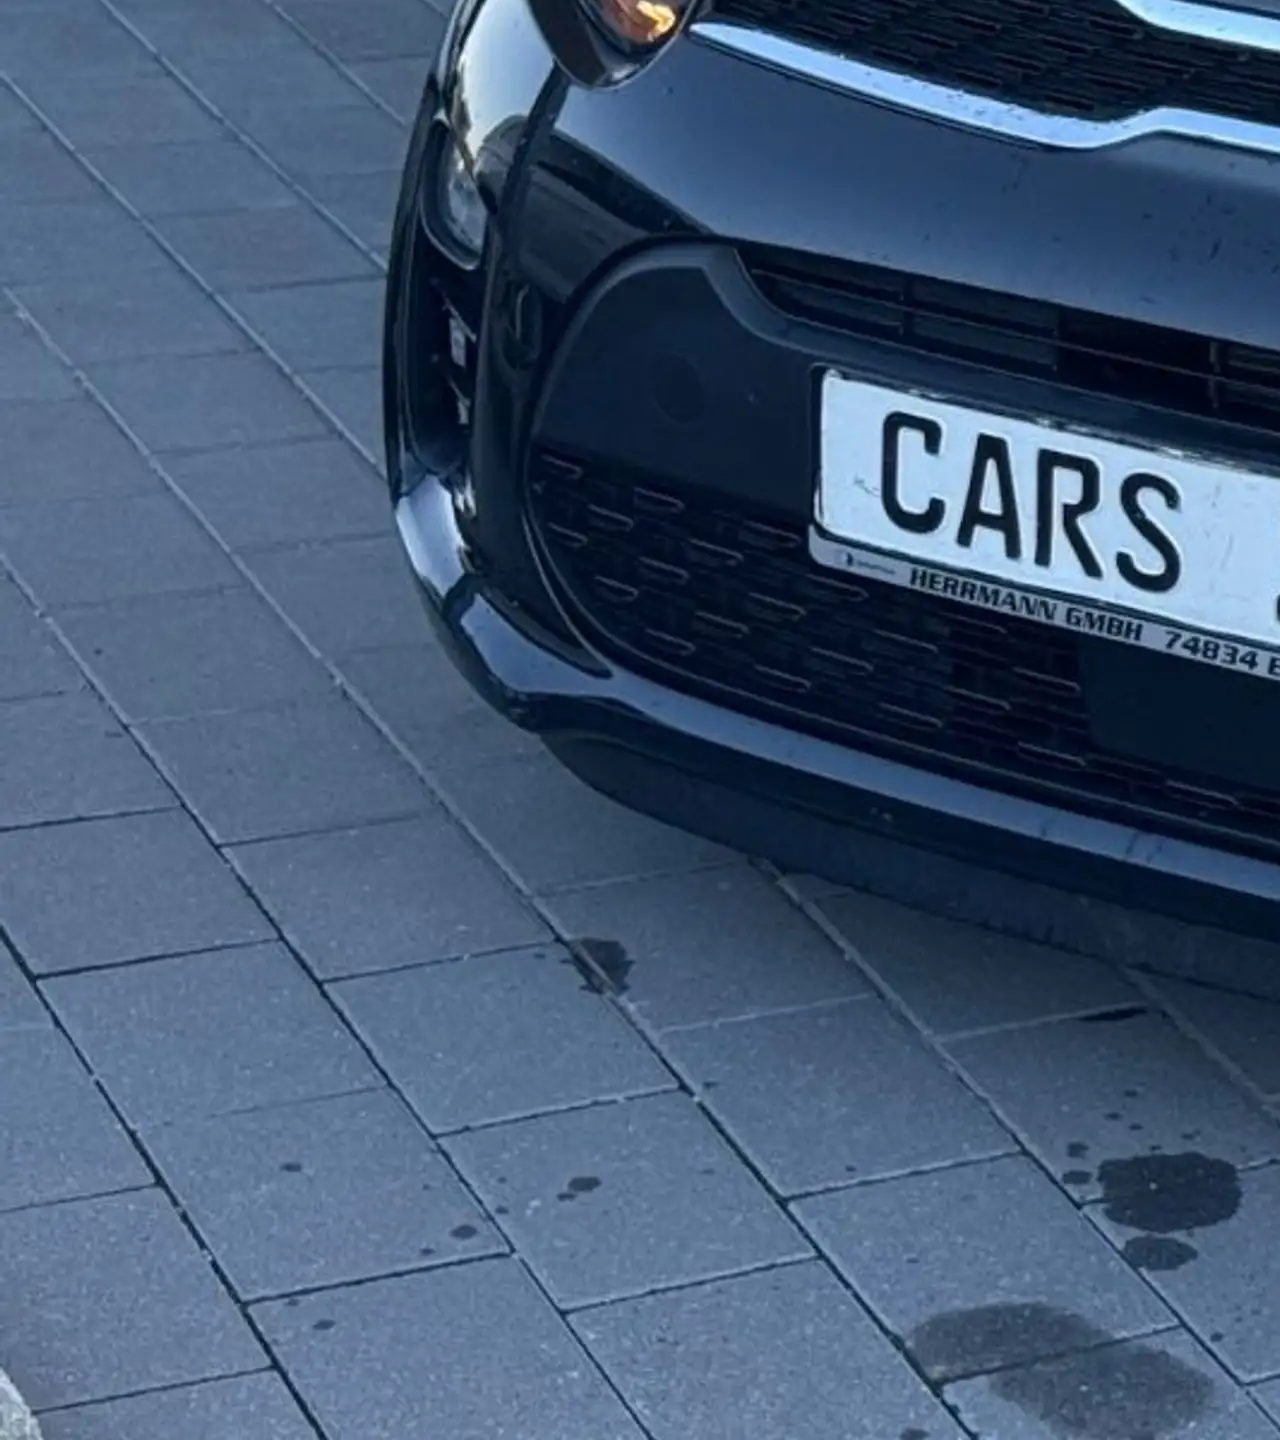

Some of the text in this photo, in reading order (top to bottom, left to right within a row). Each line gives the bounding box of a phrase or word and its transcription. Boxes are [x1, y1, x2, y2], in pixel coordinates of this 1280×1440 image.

[881, 411, 1182, 593] CARS
[909, 567, 1059, 621] HERRMANN
[1065, 606, 1144, 642] GMBH
[1165, 630, 1259, 671] 74834
